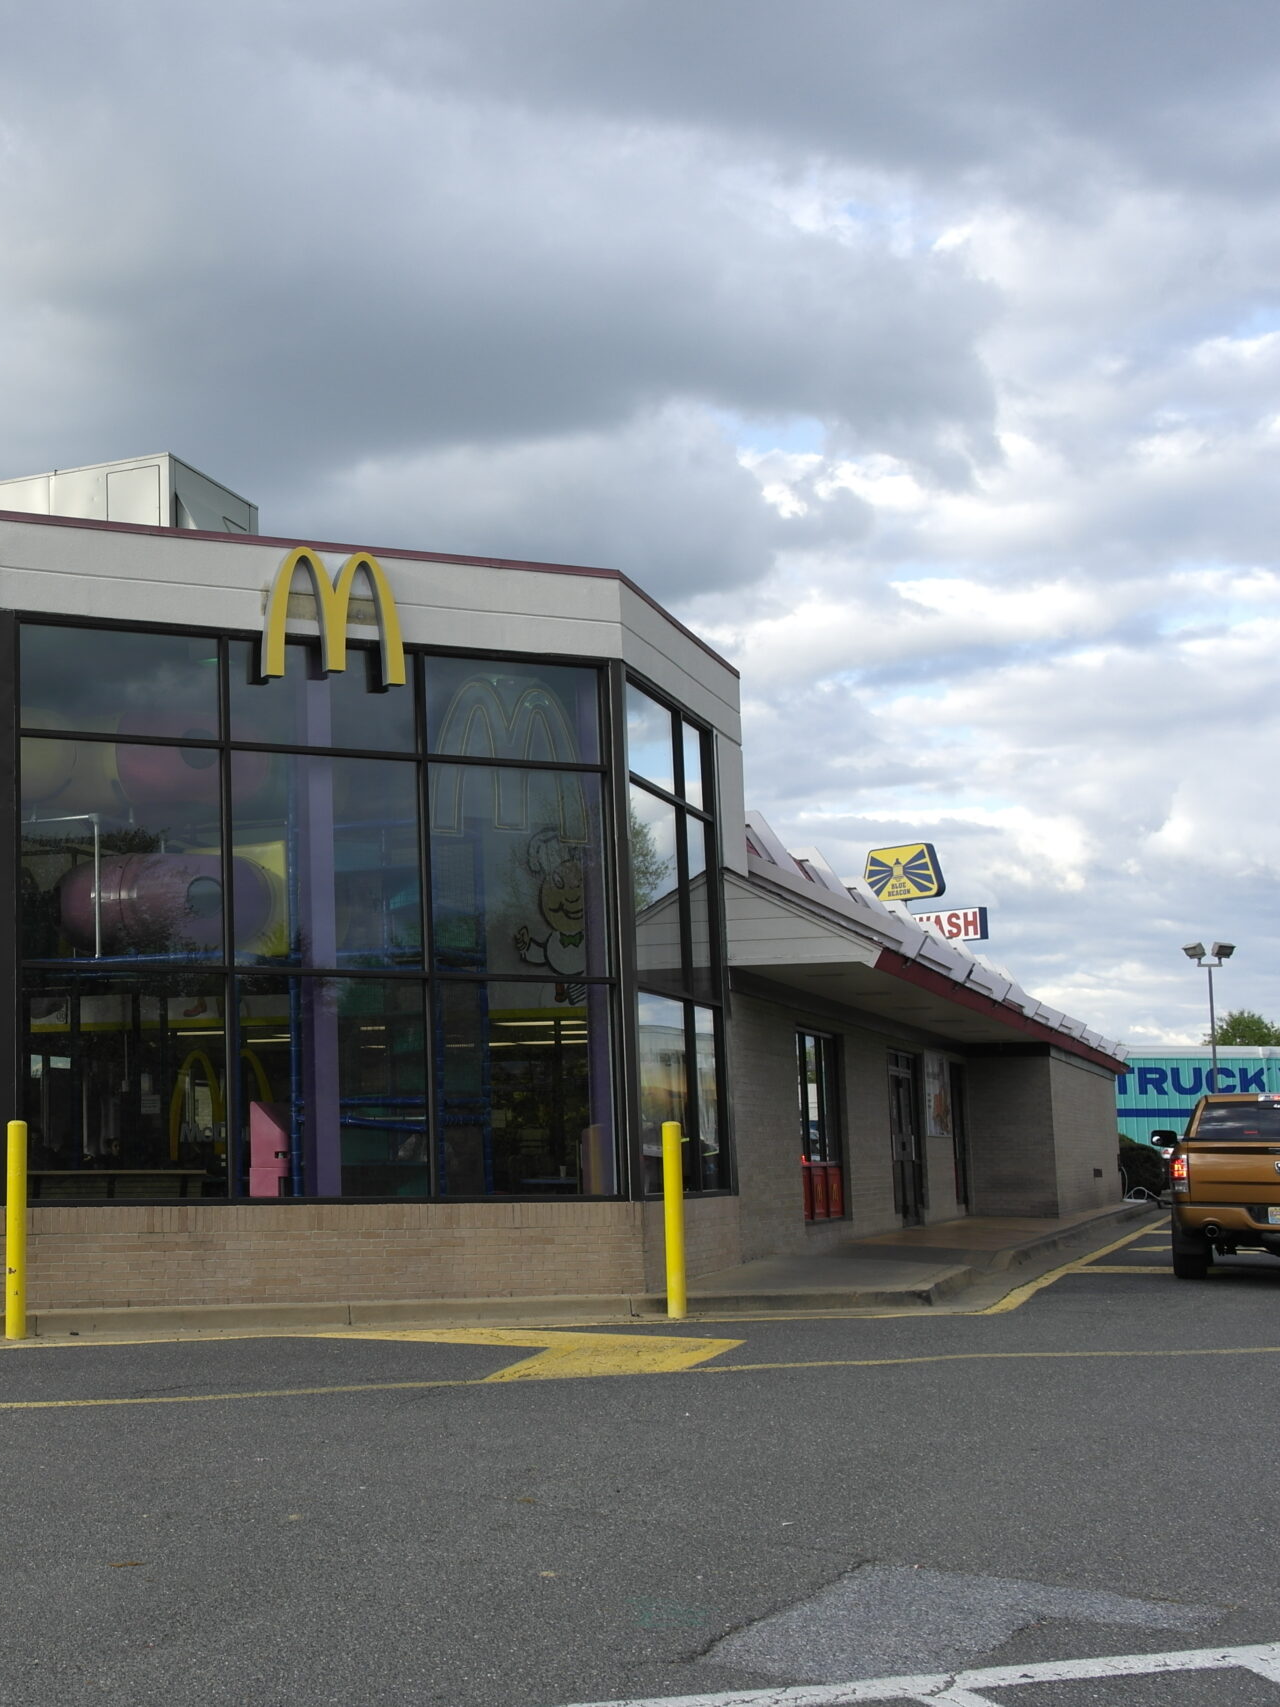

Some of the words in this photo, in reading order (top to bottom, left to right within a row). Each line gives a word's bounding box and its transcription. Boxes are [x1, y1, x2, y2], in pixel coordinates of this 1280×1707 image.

[887, 888, 911, 897] BEACON
[914, 911, 979, 938] ASH
[1117, 1066, 1266, 1096] TRUCK
